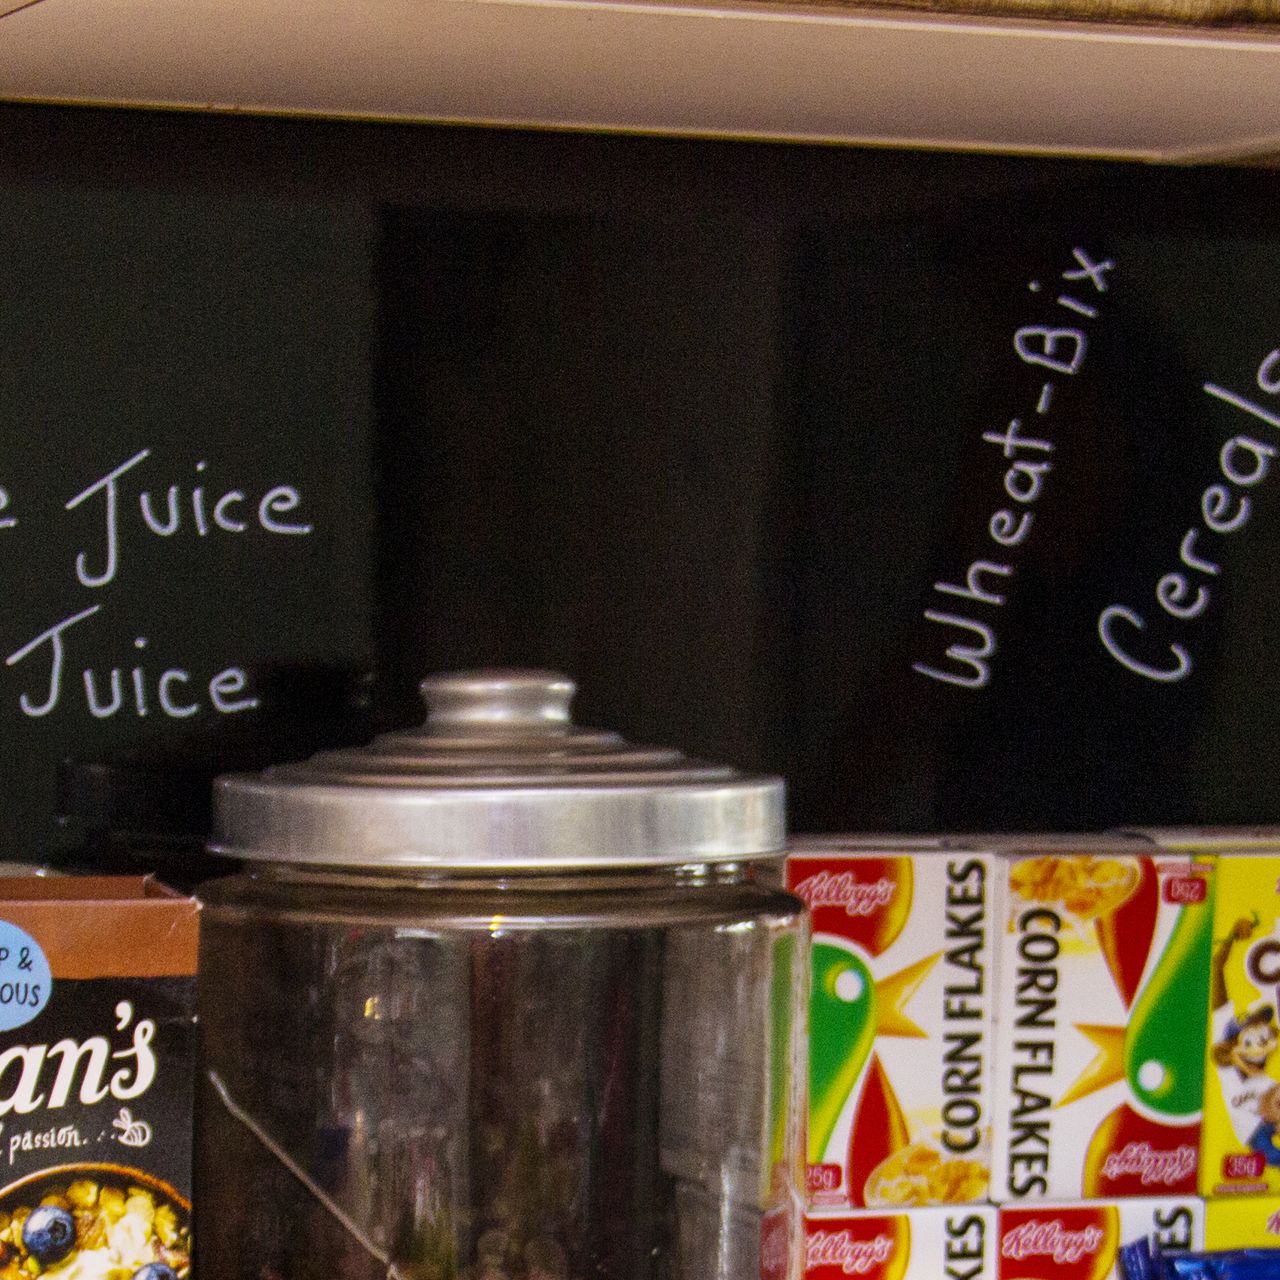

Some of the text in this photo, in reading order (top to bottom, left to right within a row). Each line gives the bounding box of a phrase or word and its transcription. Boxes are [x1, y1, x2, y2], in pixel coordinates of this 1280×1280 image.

[65, 448, 313, 588] Juice
[912, 246, 1117, 690] Wheat-Bix
[6, 604, 260, 719] Juice
[17, 943, 34, 972] &
[941, 858, 988, 1154] CORN FLAKES
[1007, 907, 1063, 1198] CORN FLAKES
[1002, 1220, 1106, 1263] Kellogg's
